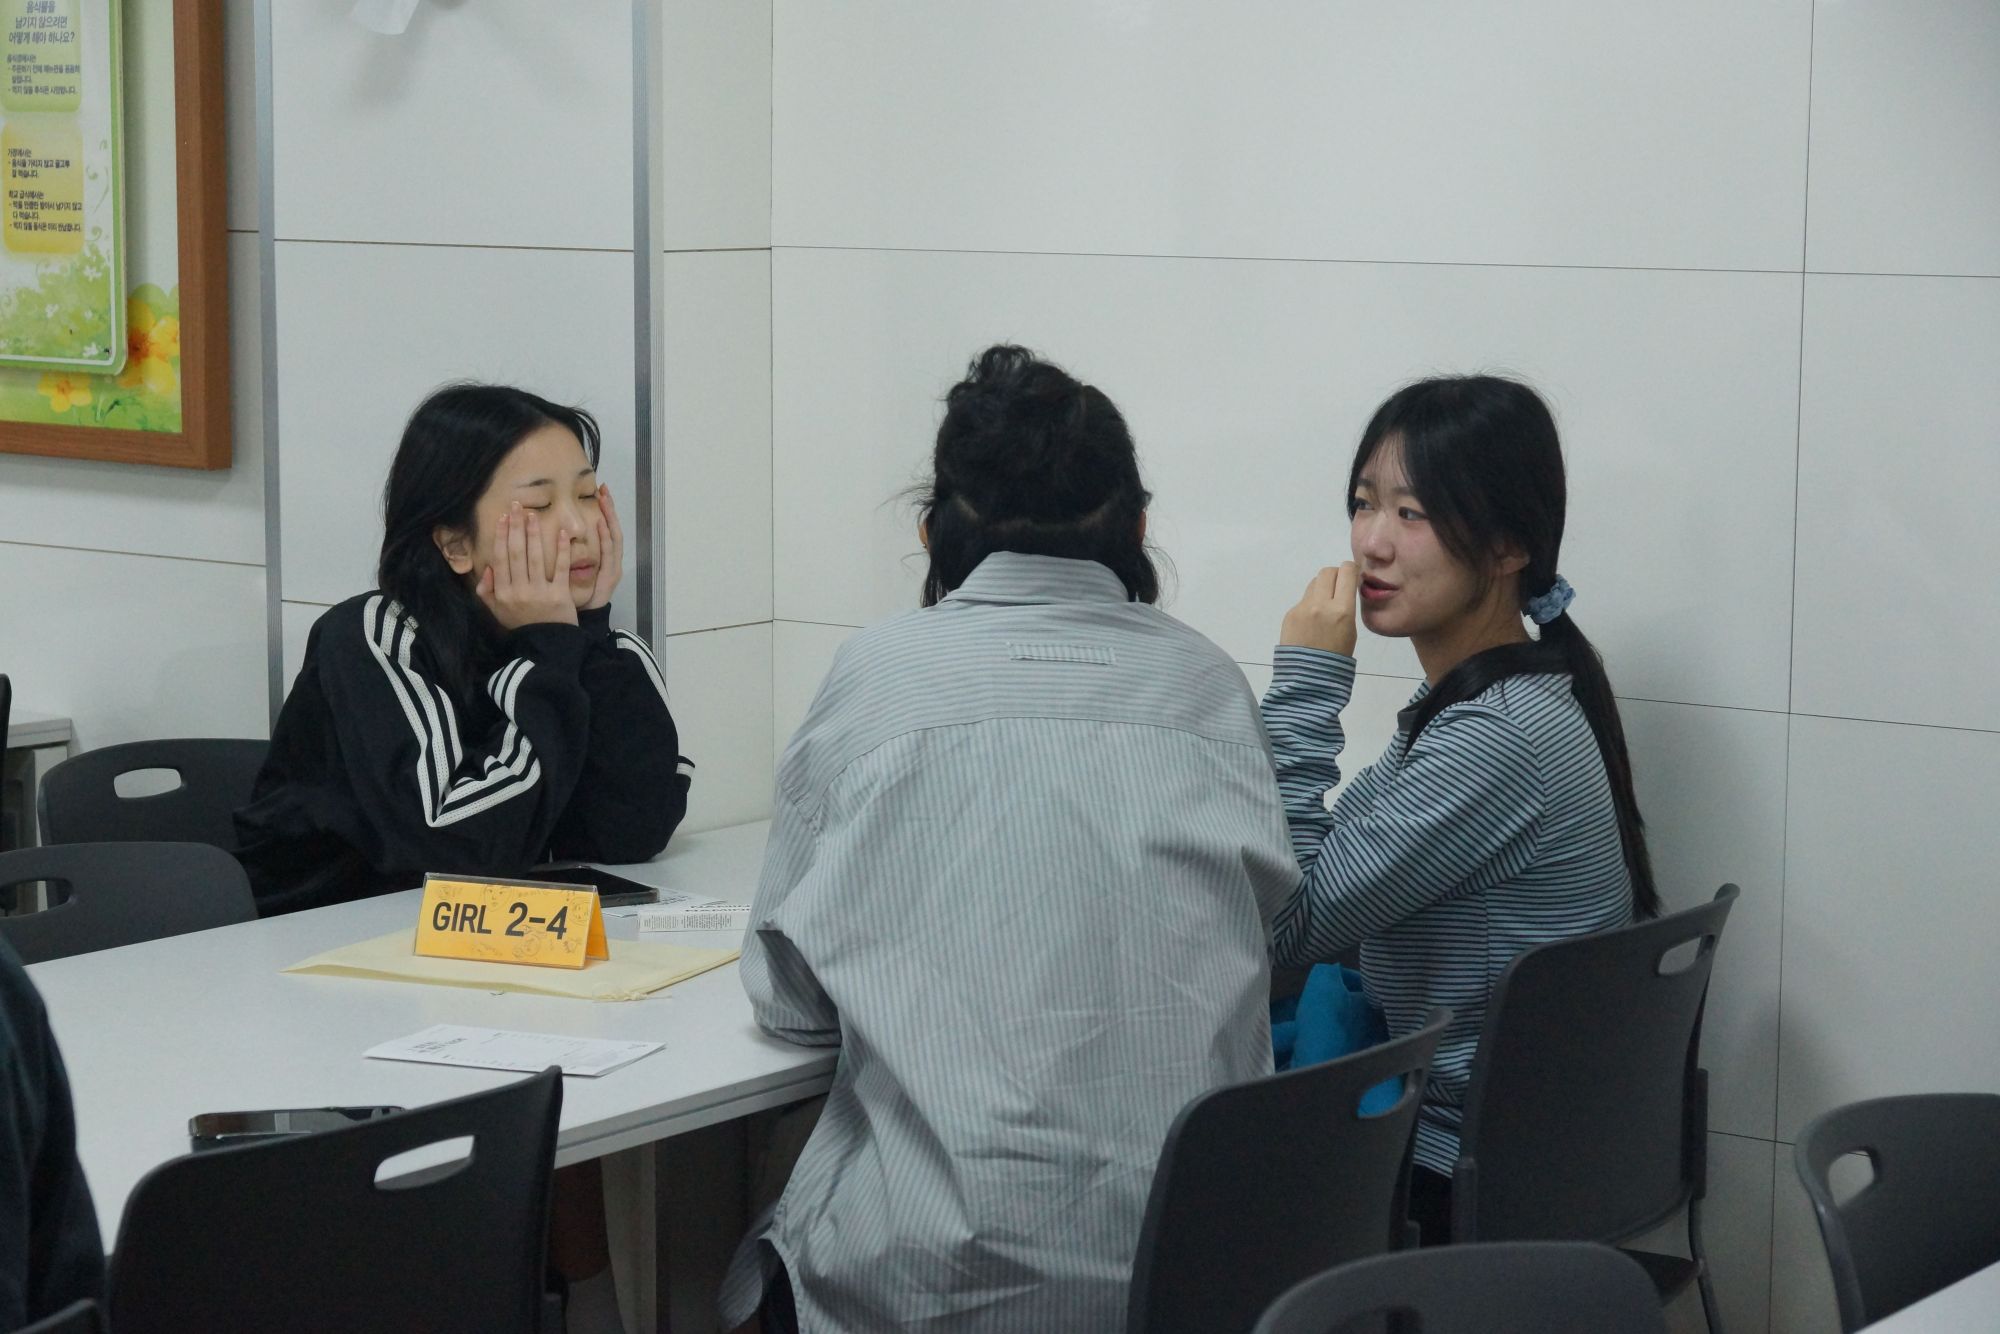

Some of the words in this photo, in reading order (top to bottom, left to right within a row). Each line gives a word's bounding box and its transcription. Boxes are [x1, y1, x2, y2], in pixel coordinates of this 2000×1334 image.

[26, 0, 56, 13] 음식물을
[15, 16, 37, 29] 남기지
[39, 16, 68, 29] 않으려면
[9, 31, 31, 44] 어떻게
[32, 32, 47, 44] 해야
[48, 31, 75, 44] 하나요?
[12, 159, 27, 168] 음식을
[55, 159, 70, 168] 골고루
[432, 901, 492, 935] GIRL
[505, 902, 568, 940] 2-4
